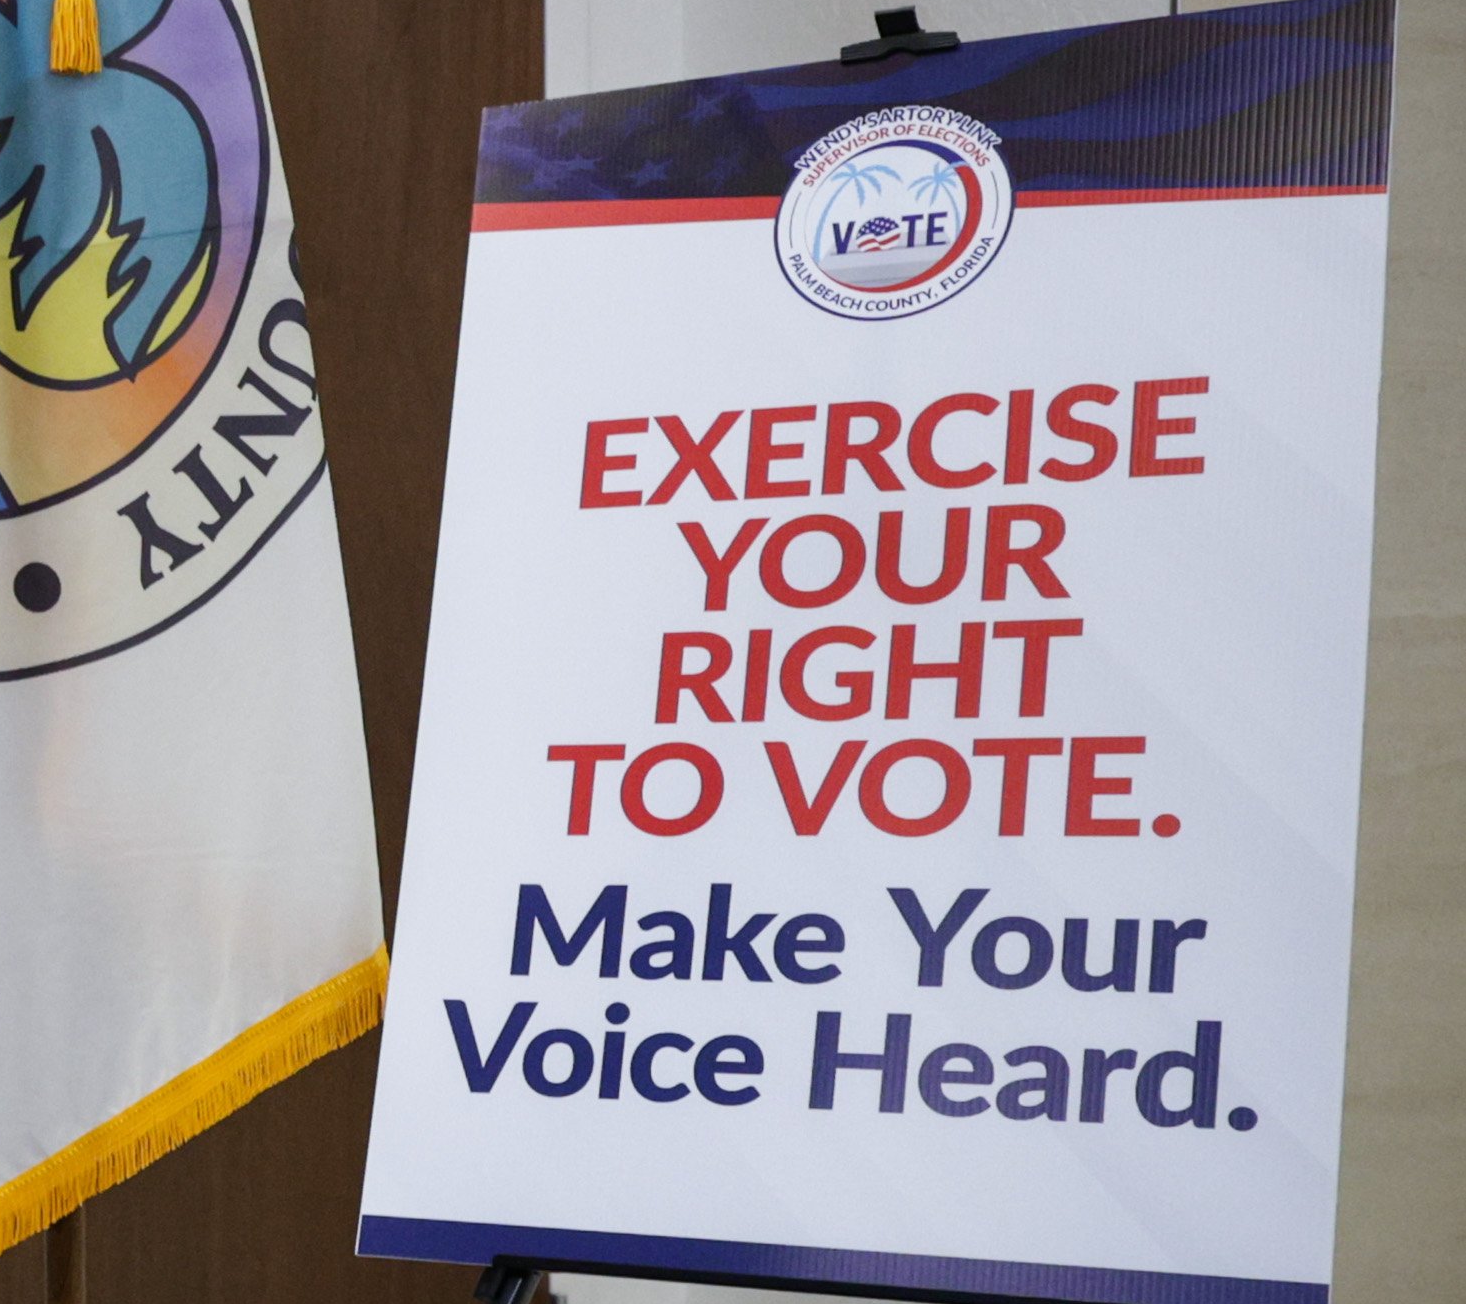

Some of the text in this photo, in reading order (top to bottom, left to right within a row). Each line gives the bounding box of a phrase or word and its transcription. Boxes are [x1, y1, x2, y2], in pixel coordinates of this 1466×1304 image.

[799, 107, 1001, 169] WENDY SARTORY LINK
[803, 124, 991, 187] SUPERVISOR OF ELECTIONS
[789, 236, 995, 313] PALM BEACH COUNTY, FLORIDA
[832, 212, 948, 255] VOTE
[579, 376, 1210, 509] EXERCISE
[677, 506, 1071, 612] YOUR
[654, 618, 1084, 724] RIGHT
[547, 736, 1181, 838] TO VOTE.
[509, 882, 1208, 994] Make Your
[443, 999, 1259, 1132] Voice Heard.
